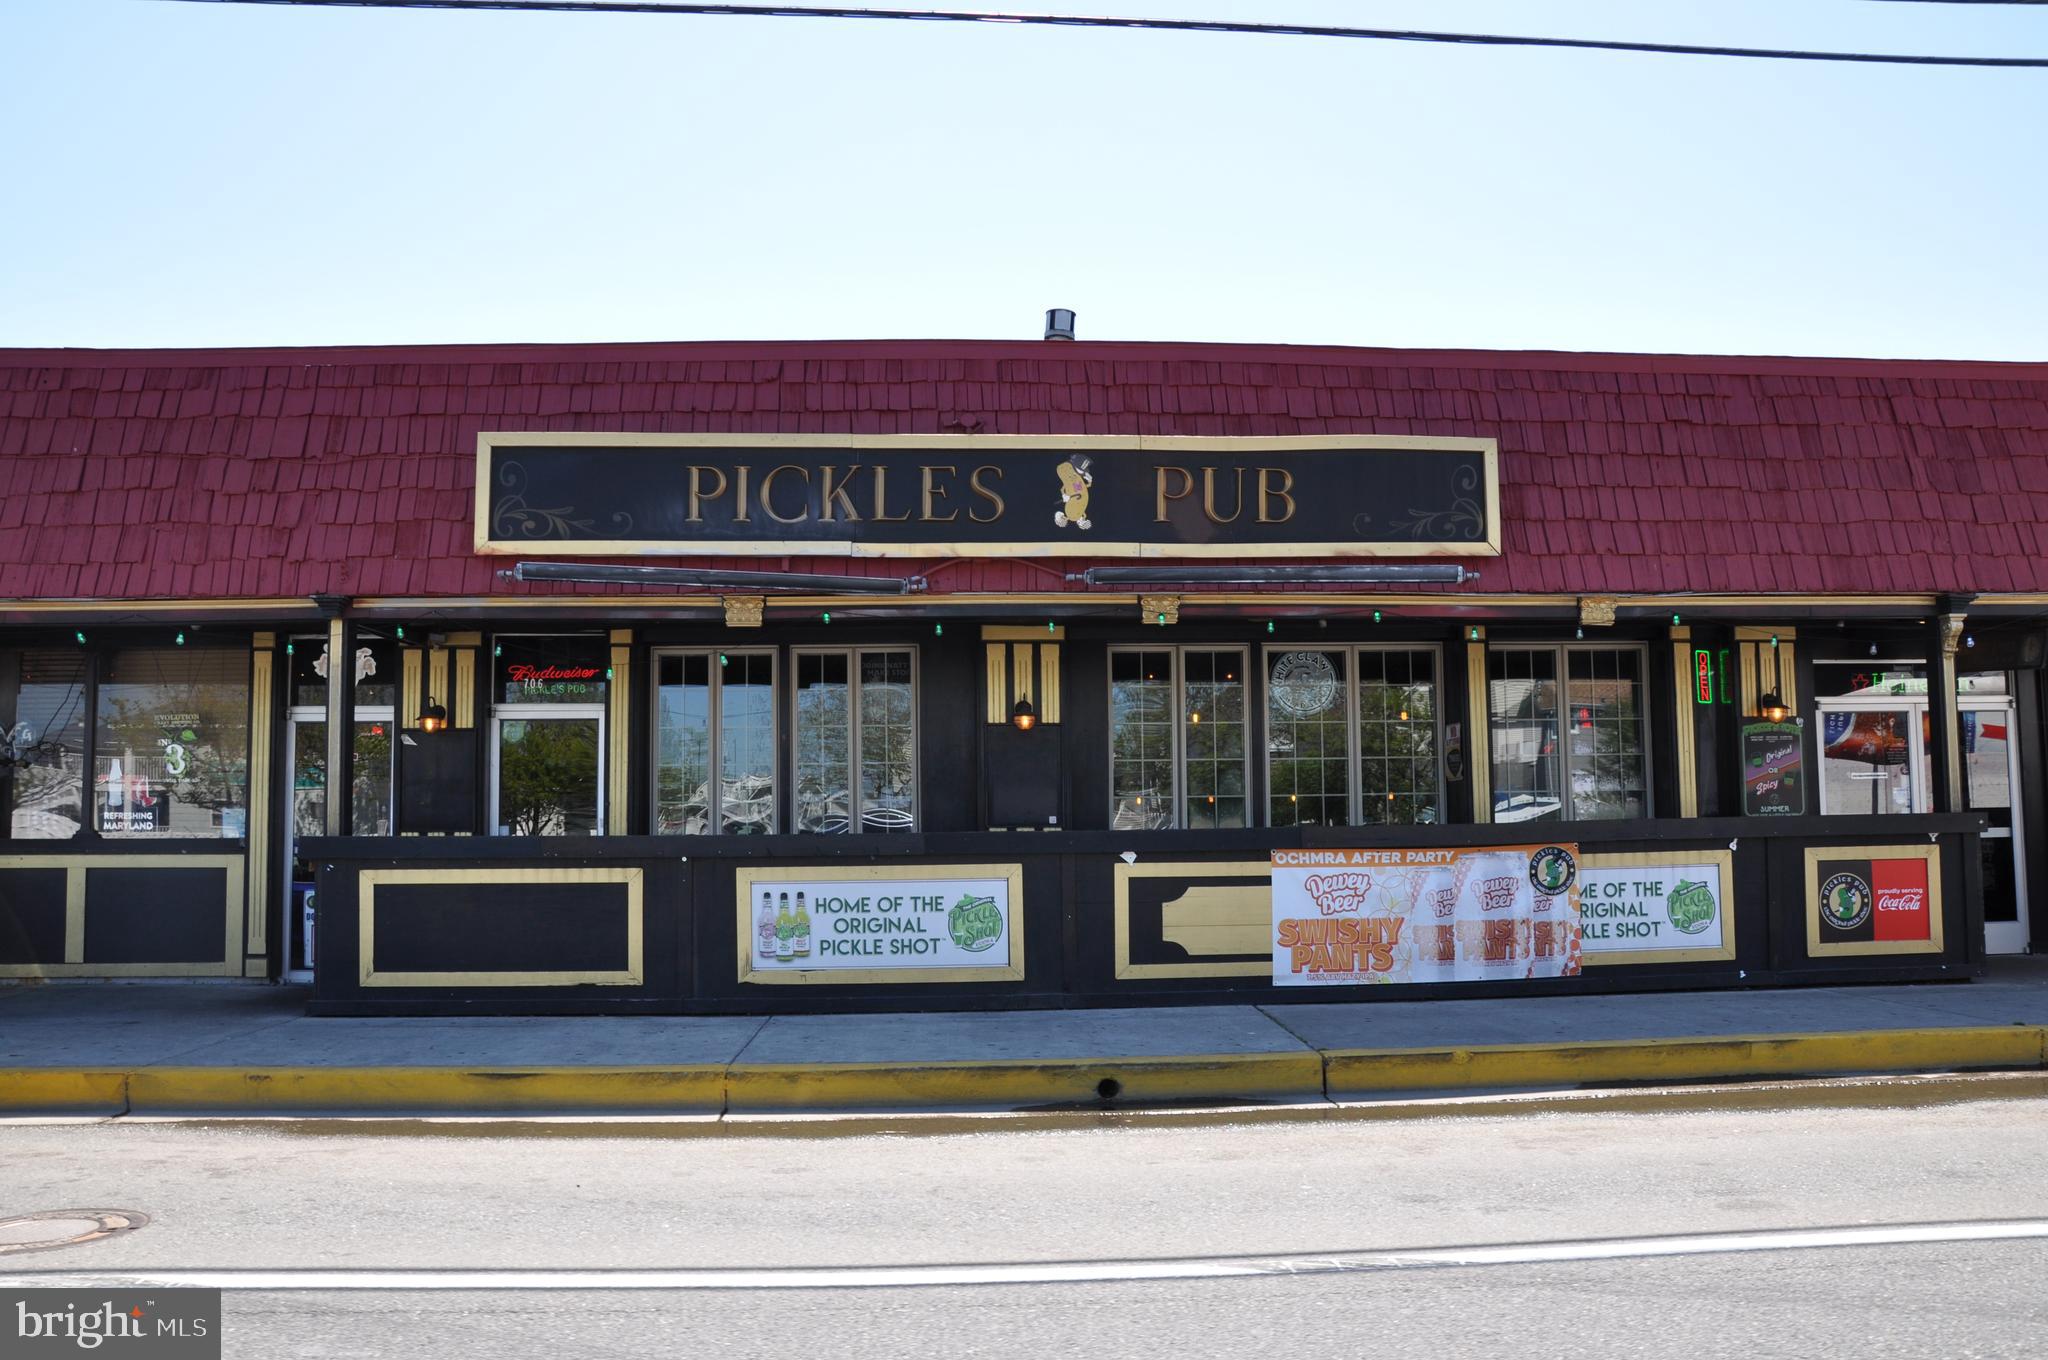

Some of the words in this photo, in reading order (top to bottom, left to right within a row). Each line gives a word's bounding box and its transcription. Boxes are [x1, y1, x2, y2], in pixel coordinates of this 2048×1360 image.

[684, 465, 1005, 523] PICKLES
[1153, 466, 1297, 523] PUB
[508, 665, 600, 681] Budweiser
[1698, 652, 1710, 701] OPEN
[523, 678, 544, 689] 706
[567, 684, 587, 694] PUB
[165, 744, 186, 775] 3
[1766, 745, 1793, 763] Original
[1756, 780, 1778, 795] Spicy
[103, 812, 153, 820] REFRESHING
[1760, 805, 1790, 813] SUMMER
[103, 822, 154, 830] MARYLAND
[1275, 852, 1346, 865] OCHMRA
[1351, 852, 1402, 864] AFTER
[1406, 851, 1454, 863] PARTY
[1305, 873, 1371, 899] Dewey
[1471, 877, 1519, 896] Dewey
[1603, 883, 1627, 898] OF
[1632, 881, 1663, 897] THE
[1824, 876, 1853, 896] pickles
[1854, 880, 1868, 896] pub
[815, 897, 871, 914] HOME
[877, 897, 904, 913] OF
[910, 896, 945, 912] THE
[1316, 893, 1365, 915] Beer
[1478, 894, 1515, 911] Beer
[1580, 901, 1648, 918] RIGINAL
[834, 917, 927, 934] ORIGINAL
[1277, 917, 1404, 948] SWISHY
[820, 939, 883, 956] PICKLE
[890, 938, 941, 955] SHOT
[1291, 942, 1394, 974] PANTS
